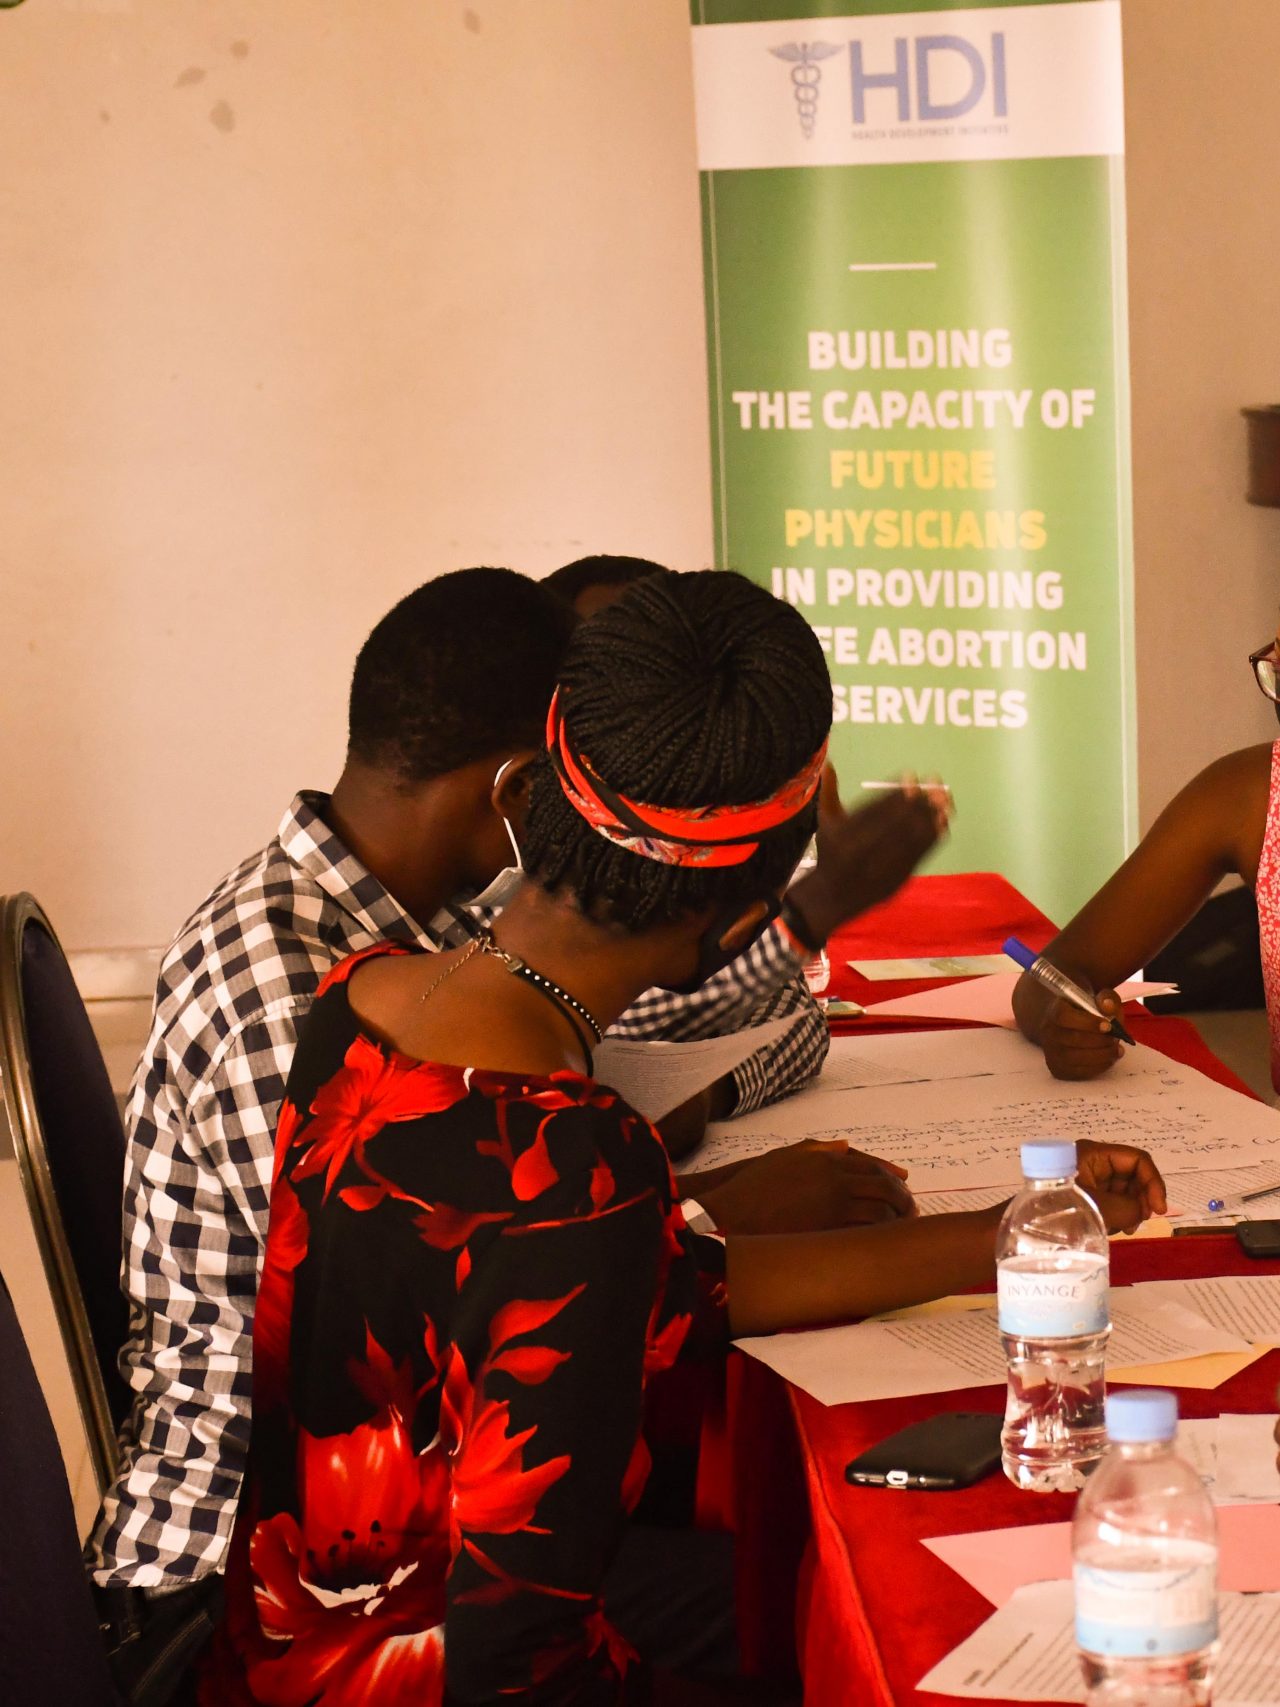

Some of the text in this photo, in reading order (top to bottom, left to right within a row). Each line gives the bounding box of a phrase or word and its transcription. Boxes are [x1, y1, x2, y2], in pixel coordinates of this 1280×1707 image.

[849, 32, 1008, 124] HDI
[808, 329, 1012, 370] BUILDING
[732, 389, 1095, 429] THE CAPACITY OF
[830, 450, 997, 490] FUTURE
[785, 509, 1047, 550] PHYSICIANS
[771, 568, 1063, 610] IN PROVIDING
[811, 626, 1088, 671] FE ABORTION
[832, 684, 1029, 729] SERVICES
[1007, 1284, 1081, 1299] INYANGE
